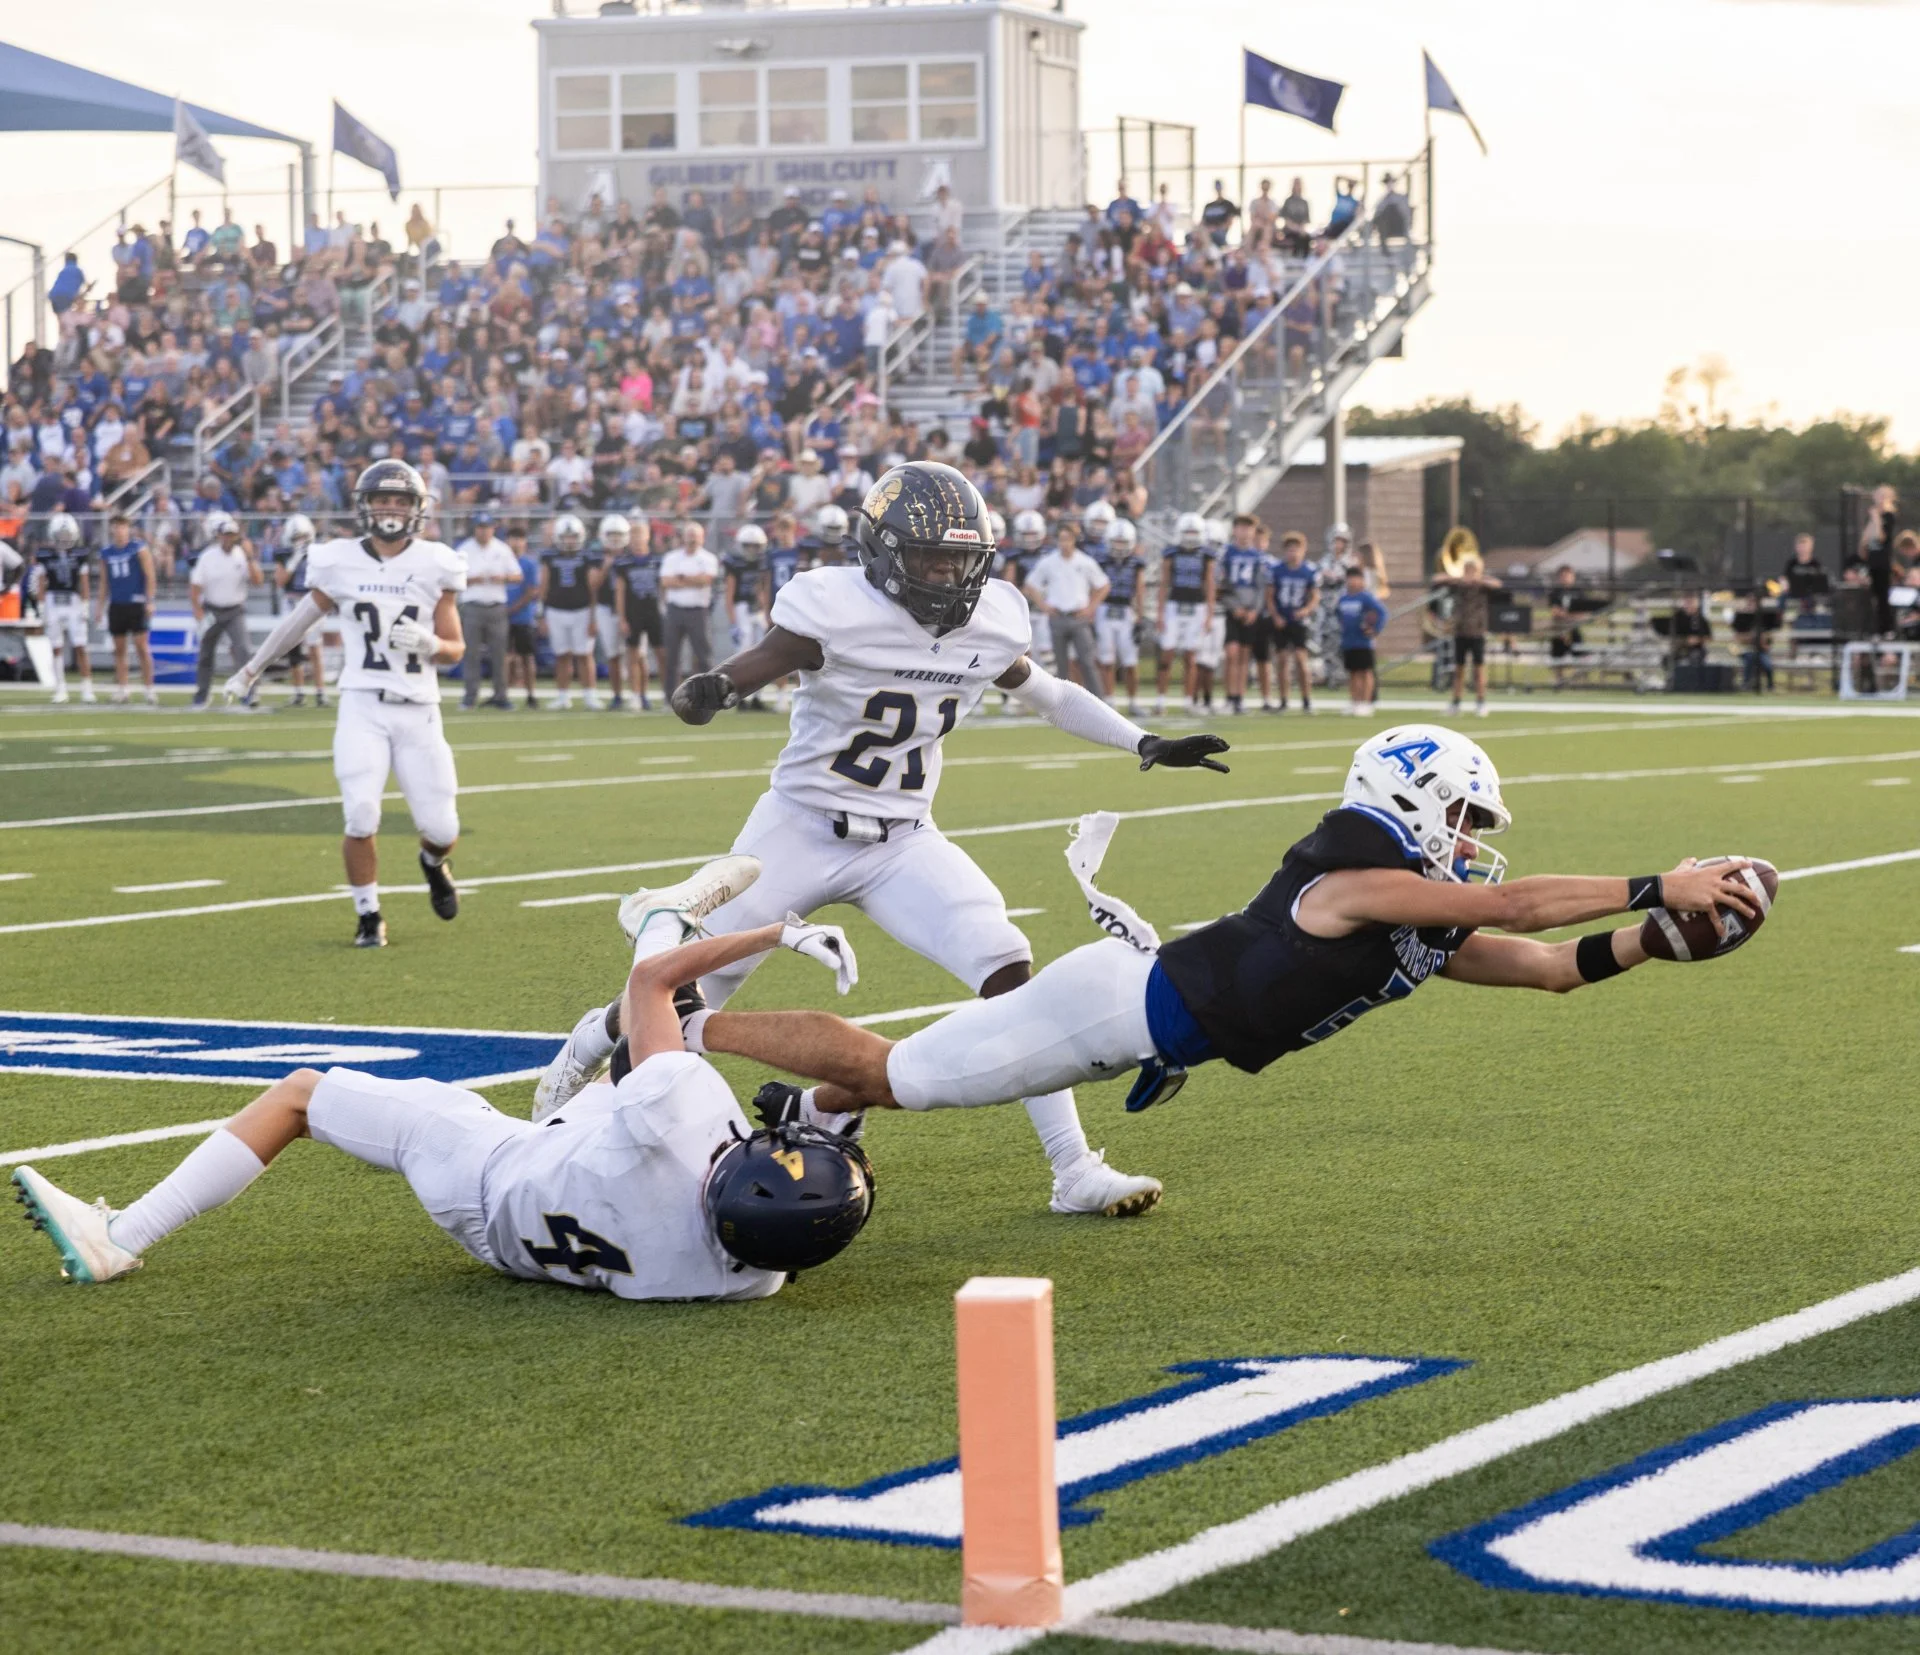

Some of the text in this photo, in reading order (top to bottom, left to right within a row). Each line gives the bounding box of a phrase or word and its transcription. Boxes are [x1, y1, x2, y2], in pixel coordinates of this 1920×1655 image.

[648, 162, 748, 187] GILBERT
[775, 159, 897, 182] SHILCUTT
[949, 532, 977, 540] Riddell
[894, 669, 964, 685] WARRIORS
[830, 689, 959, 790] 21
[1372, 735, 1445, 785] A
[1389, 924, 1456, 980] PANTHER
[520, 1212, 635, 1277] 4
